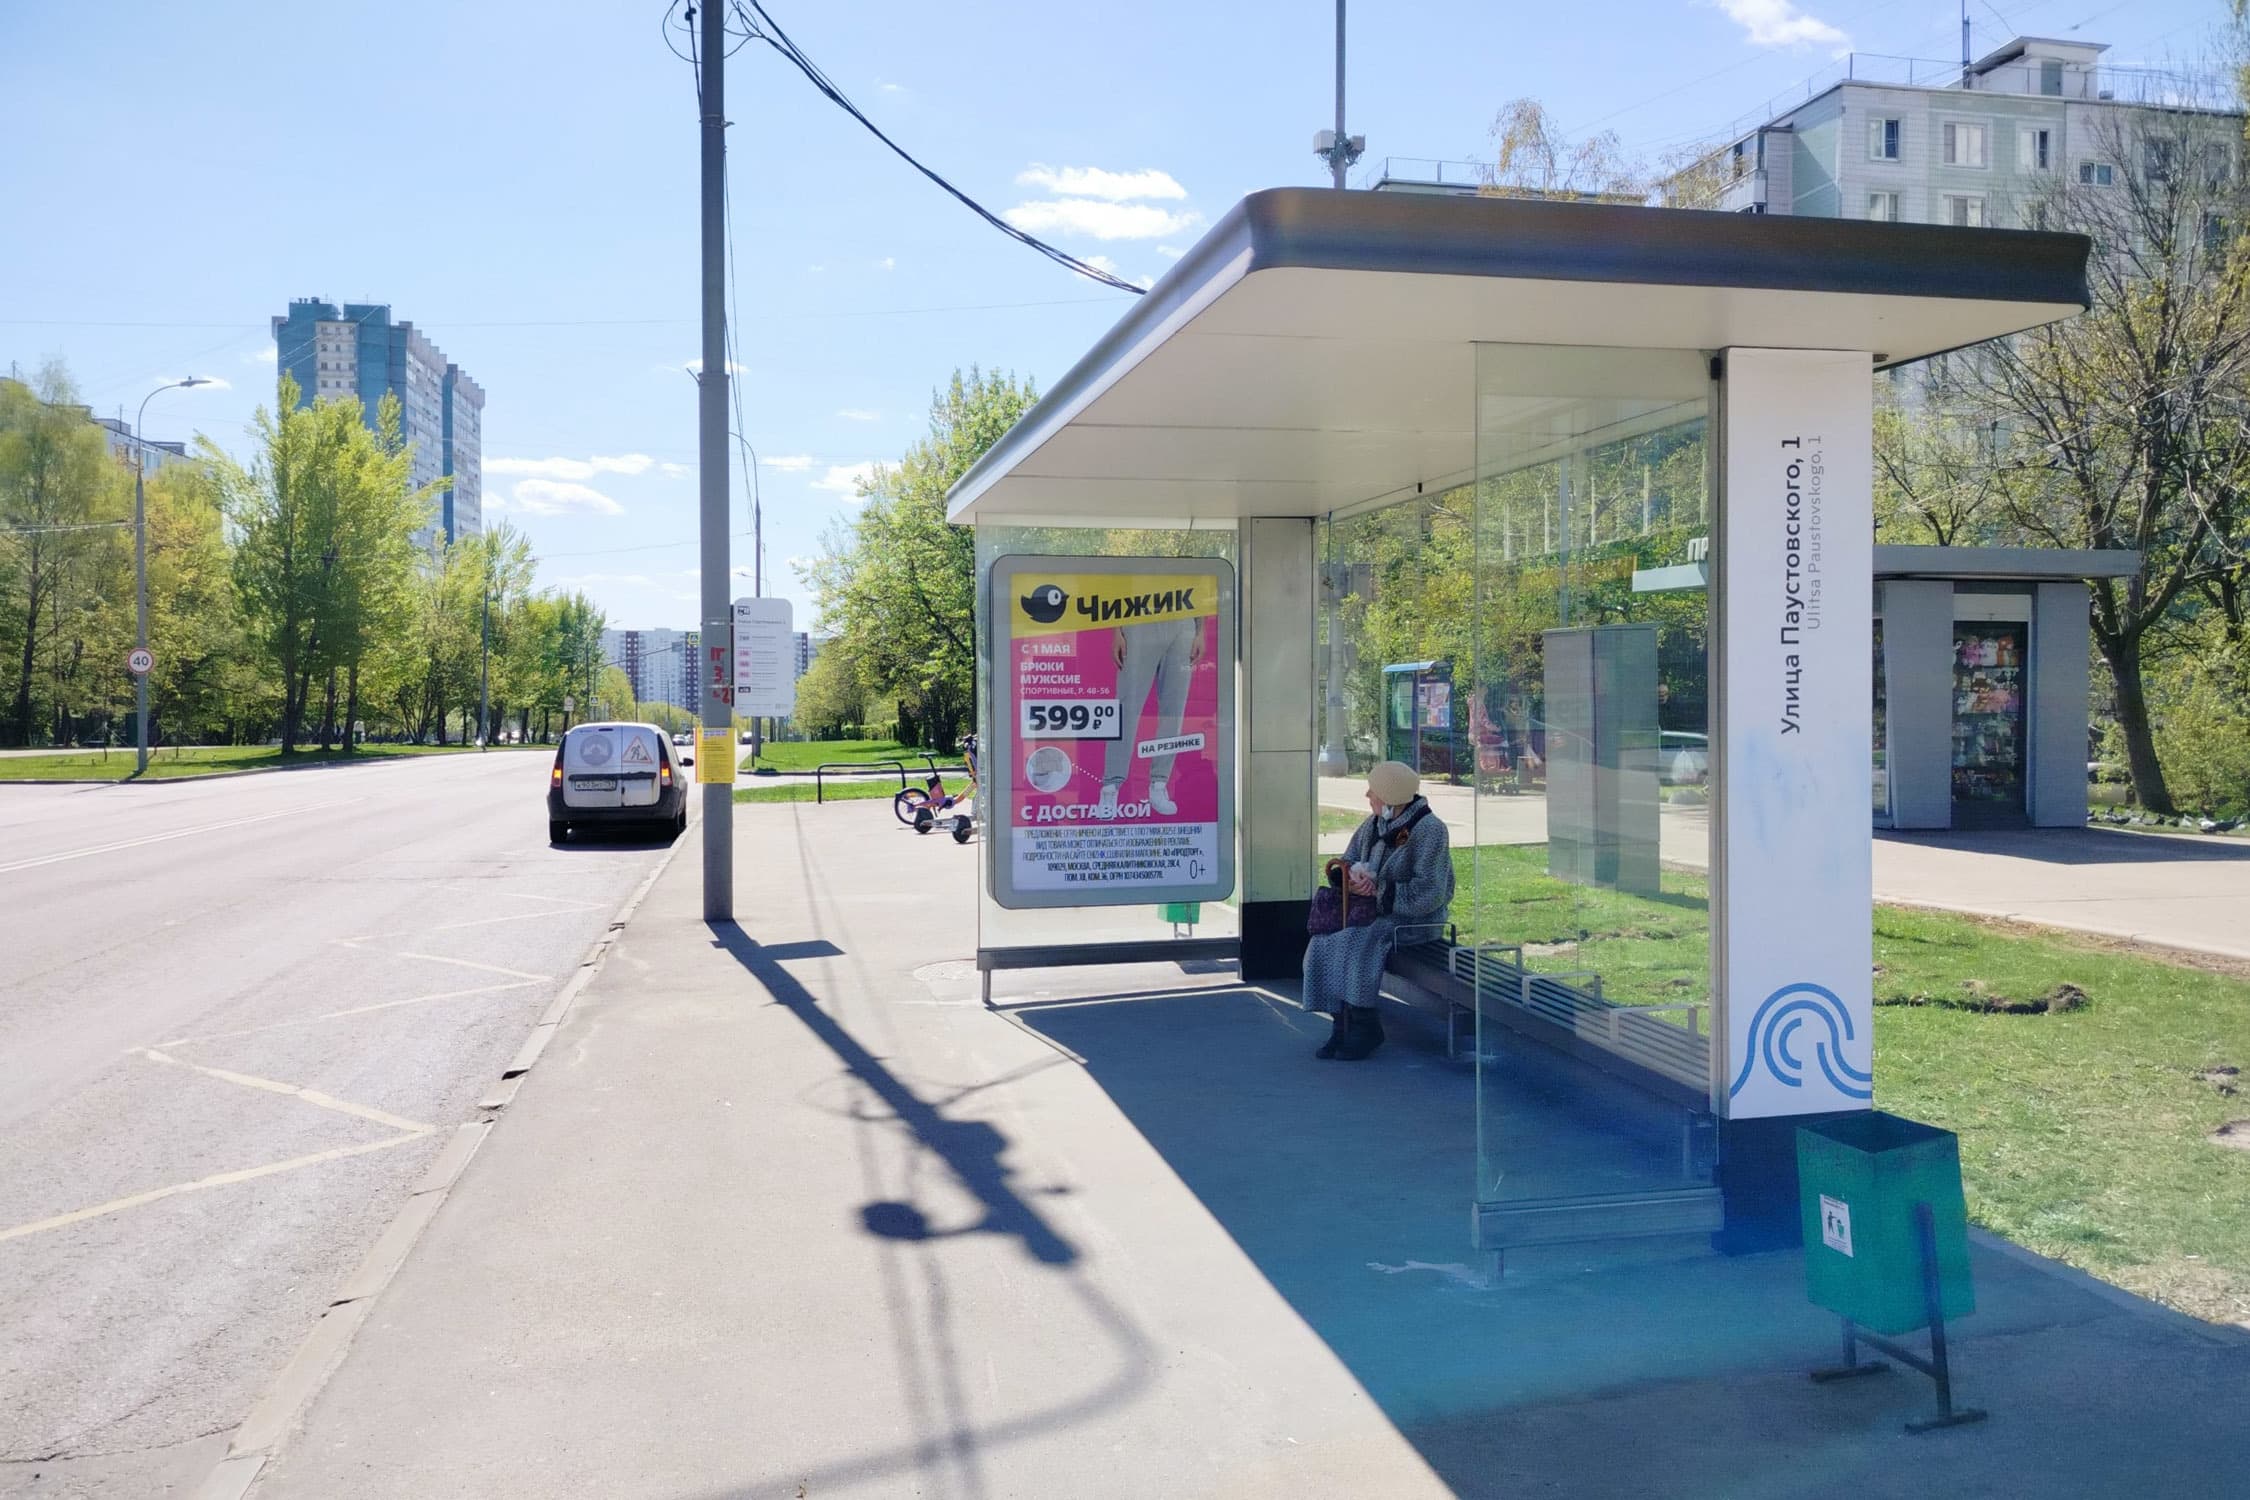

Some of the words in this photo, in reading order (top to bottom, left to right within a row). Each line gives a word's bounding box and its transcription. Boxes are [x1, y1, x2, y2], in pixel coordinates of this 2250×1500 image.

[1781, 436, 1801, 449] 1
[1807, 435, 1822, 445] 1
[1807, 450, 1824, 574] Paustovskogo,
[1781, 457, 1804, 645] Паустовского,
[1807, 579, 1822, 630] Ulitsa
[1033, 644, 1039, 654] 1
[1041, 643, 1071, 654] МАЯ
[133, 656, 149, 666] 40
[1020, 661, 1065, 672] БРЮКИ
[1020, 674, 1081, 685] МУЖСКИЕ
[1781, 654, 1803, 735] Улица
[1028, 705, 1090, 731] 599
[1094, 705, 1114, 718] 00
[1141, 742, 1155, 754] НА
[1157, 738, 1201, 751] РЕЗИНКЕ
[1020, 805, 1033, 821] С
[1036, 799, 1152, 822] ДОСТАВКОЙ
[1189, 859, 1207, 880] 0+
